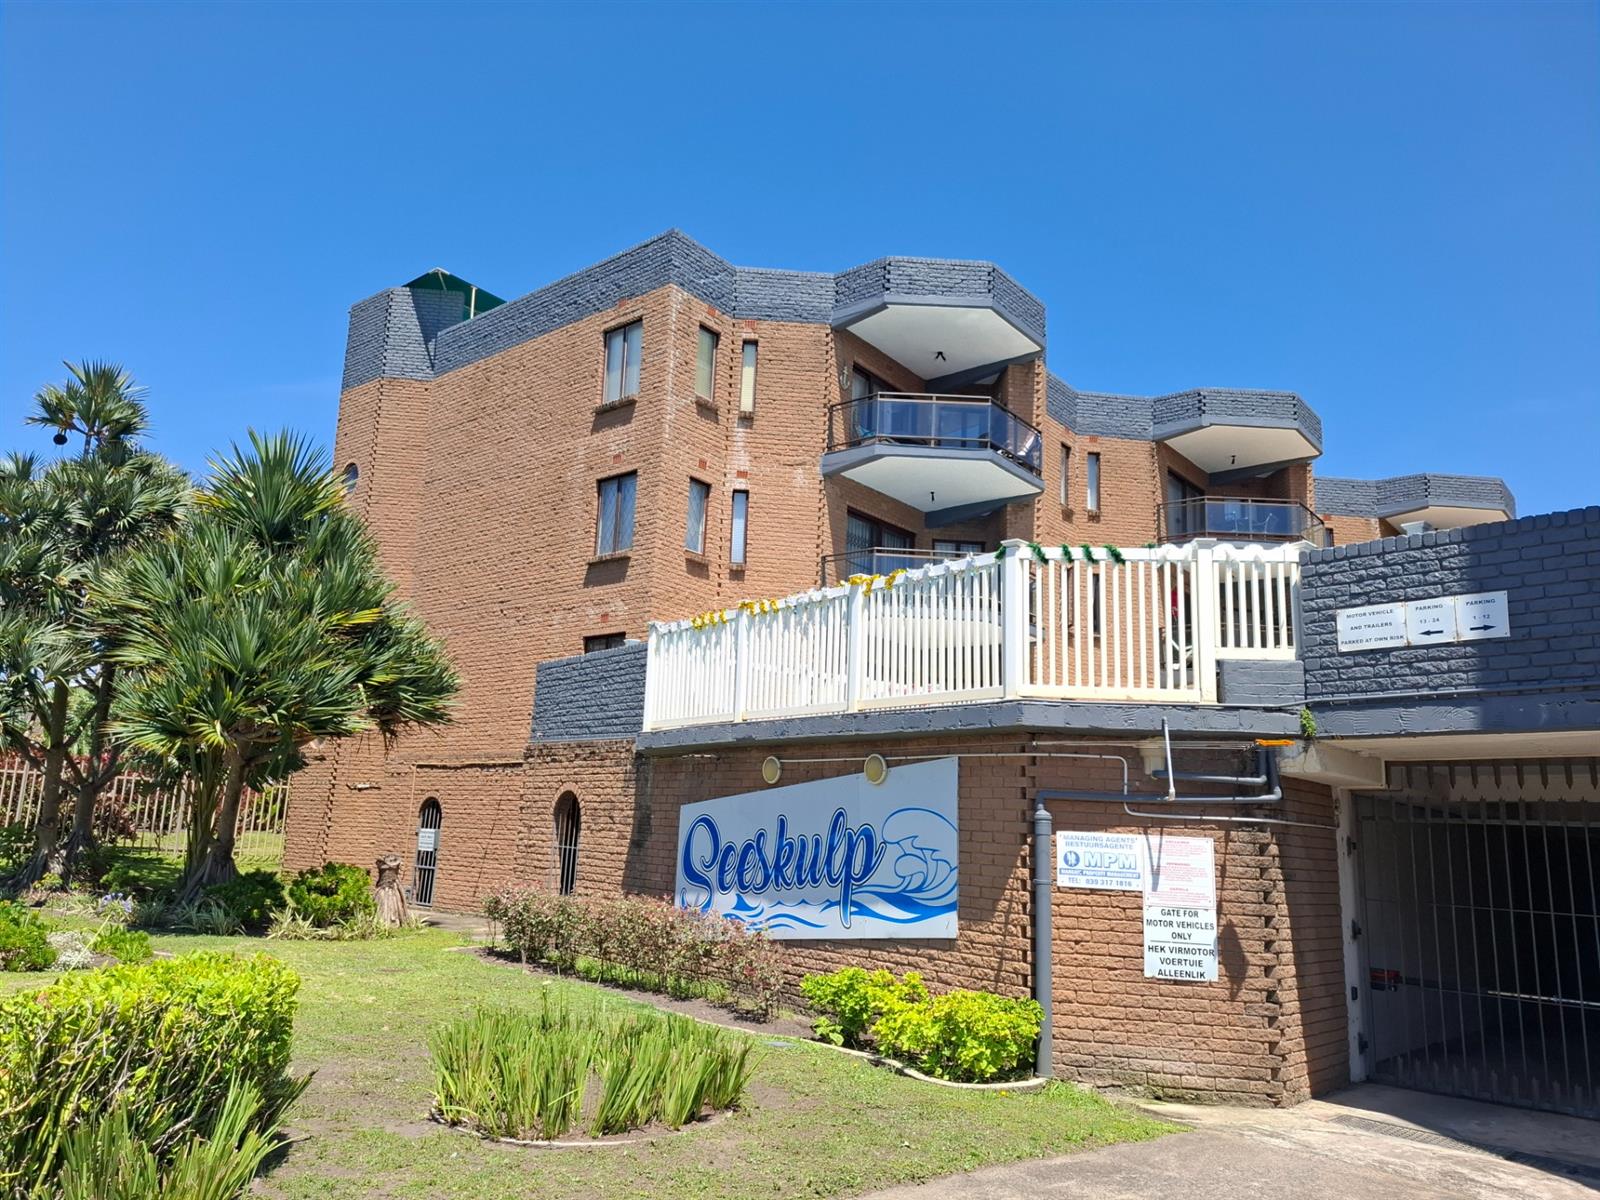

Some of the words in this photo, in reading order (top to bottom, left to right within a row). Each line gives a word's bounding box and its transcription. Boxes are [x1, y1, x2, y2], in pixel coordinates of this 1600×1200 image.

[1465, 598, 1496, 606] PARKING
[1346, 611, 1367, 619] MOTOR
[1368, 608, 1393, 616] VEHICLE
[1363, 621, 1392, 629] TRAILERS
[1065, 841, 1133, 850] BESTUURSAGENTE
[1084, 850, 1137, 870] MPM
[680, 807, 887, 929] Seeskulp
[1161, 908, 1181, 917] GATE
[1184, 910, 1199, 918] FOR
[1146, 919, 1174, 928] MOTOR
[1176, 921, 1214, 930] VEHICLES
[1171, 932, 1192, 940] ONLY
[1148, 945, 1166, 953] HEK
[1169, 946, 1215, 957] VIRMOTOR
[1160, 957, 1203, 967] VOERTUIE
[1158, 969, 1206, 979] ALLEENLIK
